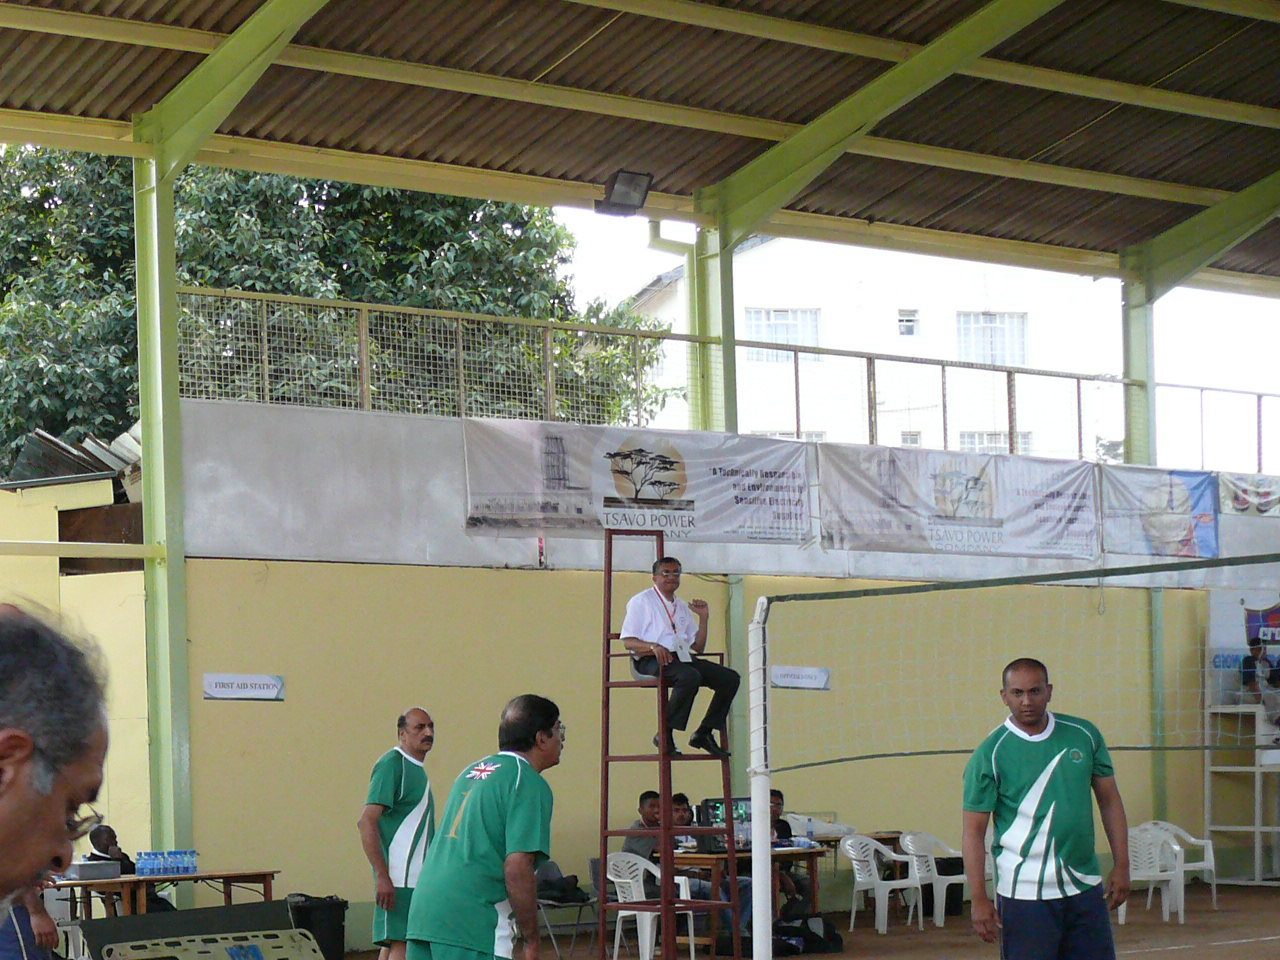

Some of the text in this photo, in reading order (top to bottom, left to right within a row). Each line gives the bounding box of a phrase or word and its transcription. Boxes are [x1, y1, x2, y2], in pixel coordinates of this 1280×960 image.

[603, 512, 696, 528] TSAVO POWER
[928, 528, 1004, 544] TSAVO POWER
